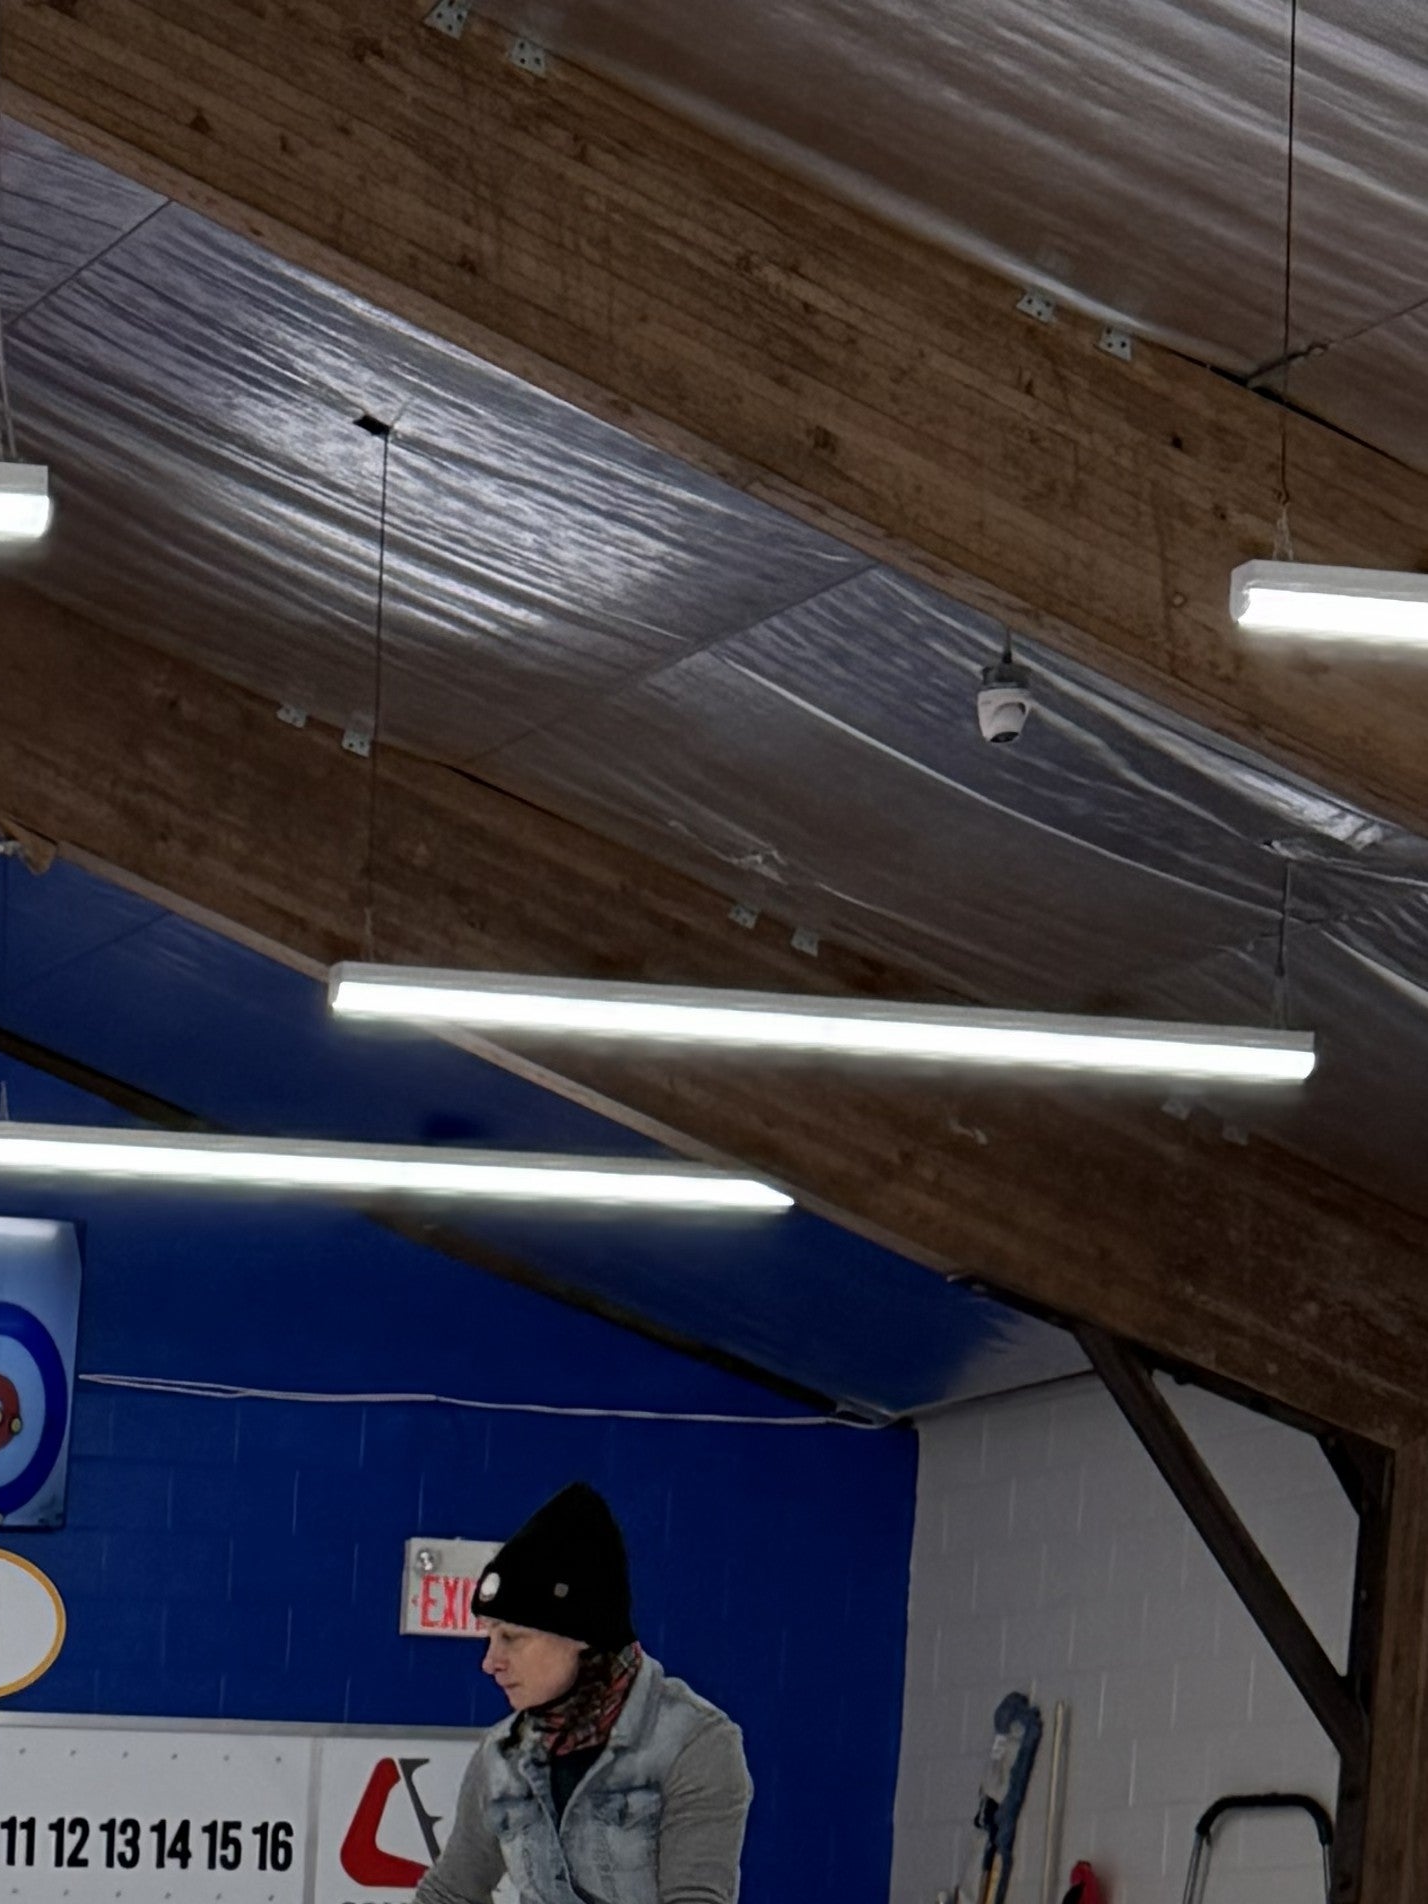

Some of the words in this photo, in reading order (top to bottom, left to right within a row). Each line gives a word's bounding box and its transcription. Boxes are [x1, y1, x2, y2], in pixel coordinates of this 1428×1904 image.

[0, 1815, 36, 1867] 11
[48, 1816, 90, 1868] 12
[98, 1817, 141, 1870] 13
[149, 1818, 193, 1870] 14
[201, 1819, 243, 1871] 15
[251, 1821, 294, 1872] 16
